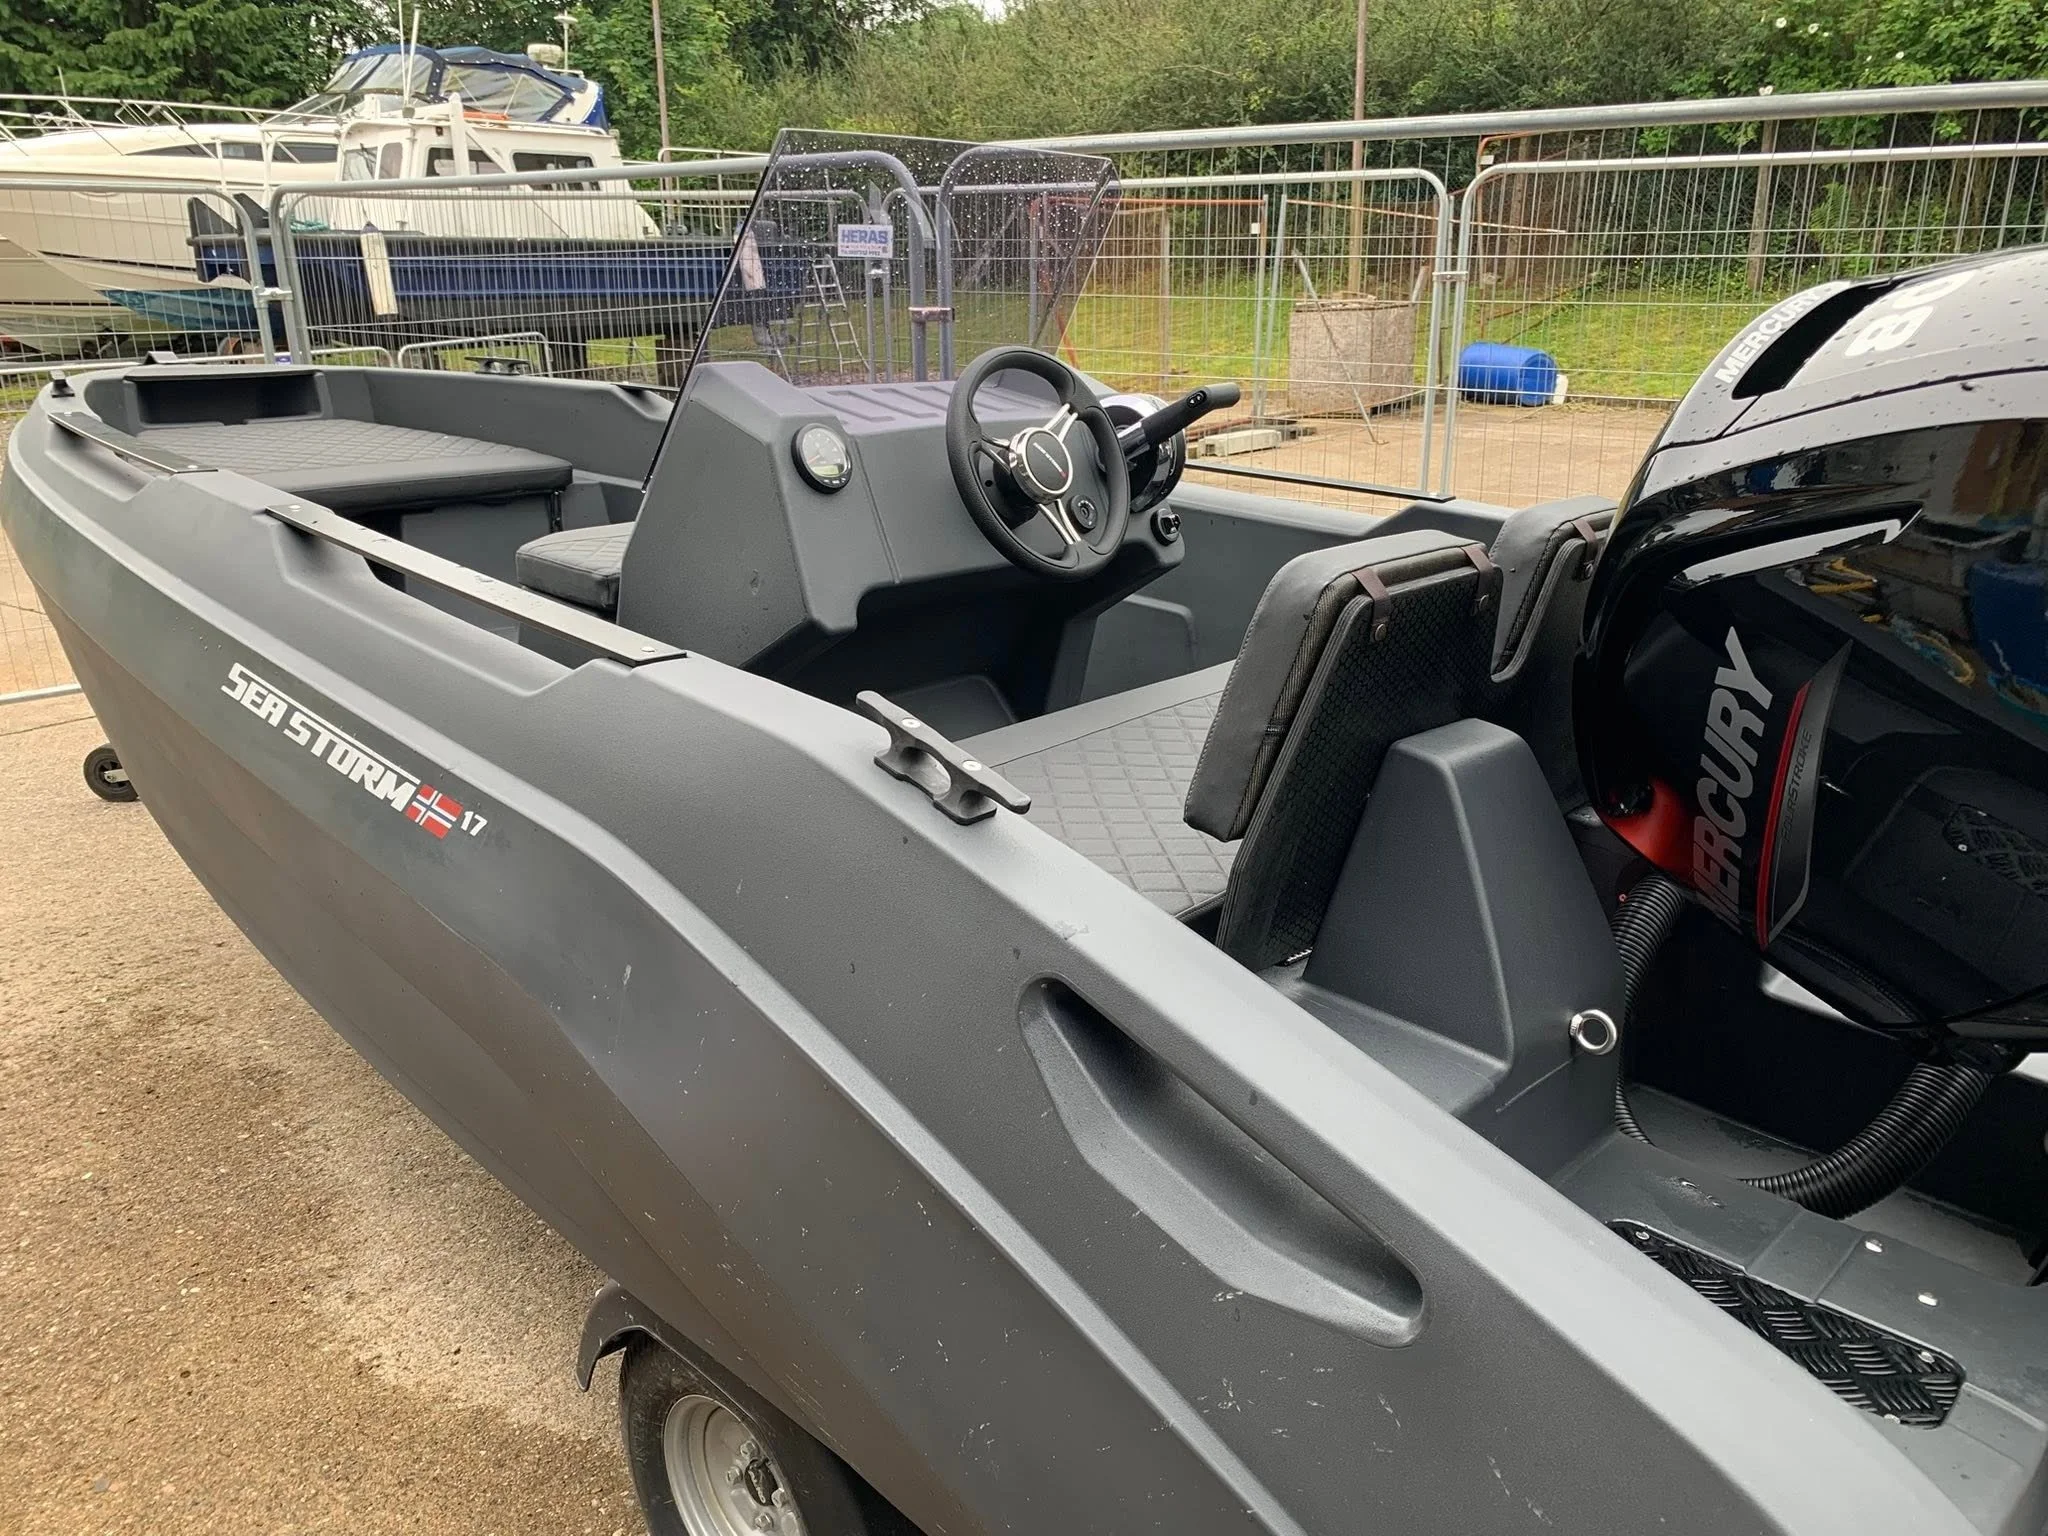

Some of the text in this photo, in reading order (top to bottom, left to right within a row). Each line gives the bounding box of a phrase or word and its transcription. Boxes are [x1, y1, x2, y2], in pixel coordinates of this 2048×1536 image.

[841, 229, 889, 245] HERAS
[1714, 290, 1821, 384] MERCURY
[1844, 269, 1977, 356] 80
[220, 662, 488, 838] SEA STORM 17
